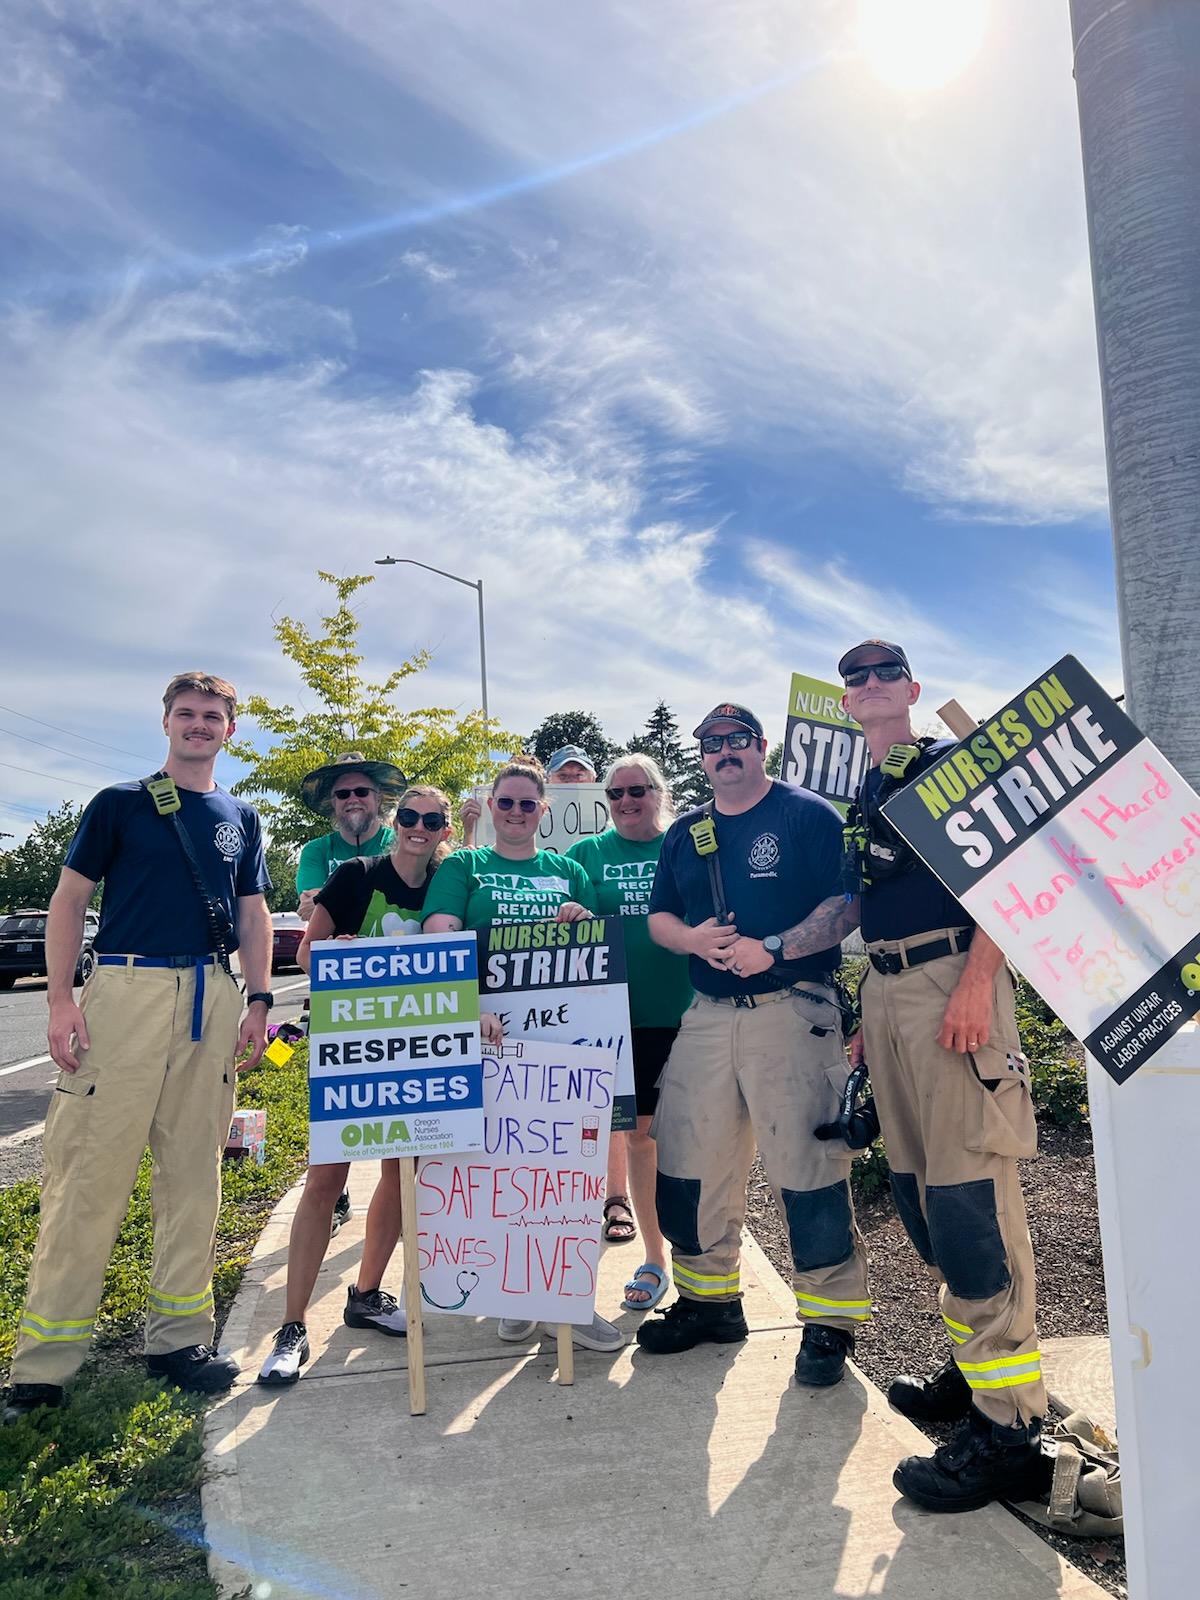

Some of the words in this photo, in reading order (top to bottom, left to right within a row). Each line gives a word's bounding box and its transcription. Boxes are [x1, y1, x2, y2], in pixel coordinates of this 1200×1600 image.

[795, 690, 857, 722] NURS
[786, 722, 872, 799] STRI
[914, 709, 1033, 821] NURSES
[1024, 673, 1075, 729] ON
[945, 705, 1117, 868] STRIKE
[563, 801, 609, 834] OLD
[992, 836, 1097, 934] Honk
[1081, 762, 1172, 840] Hard
[491, 890, 562, 903] RECRUIT
[497, 903, 559, 917] RETAIN
[619, 903, 649, 916] RES
[624, 891, 651, 902] RET
[488, 922, 571, 951] NURSES
[576, 919, 606, 944] ON
[318, 949, 471, 982] RECRUIT
[486, 945, 610, 989] STRIKE
[331, 991, 459, 1023] RETAIN
[523, 1003, 570, 1031] ARE
[1100, 1015, 1136, 1054] AGAINST
[1130, 991, 1163, 1023] UNFAIR
[319, 1032, 474, 1067] RESPECT
[1112, 1038, 1144, 1069] LABOR
[1138, 1000, 1183, 1045] PRACTICES
[324, 1075, 470, 1111] NURSES
[481, 1058, 613, 1109] PATIENTS
[341, 1120, 412, 1148] ONA
[414, 1118, 441, 1127] Oregon
[414, 1126, 439, 1134] Nurses
[414, 1133, 454, 1142] Association
[484, 1117, 574, 1155] URSE
[343, 1148, 361, 1157] Voice
[361, 1147, 369, 1156] of
[370, 1146, 394, 1156] Oregon
[395, 1145, 420, 1153] Nurses
[420, 1143, 438, 1151] Since
[417, 1232, 497, 1271] SAVES
[502, 1232, 598, 1297] LIVES
